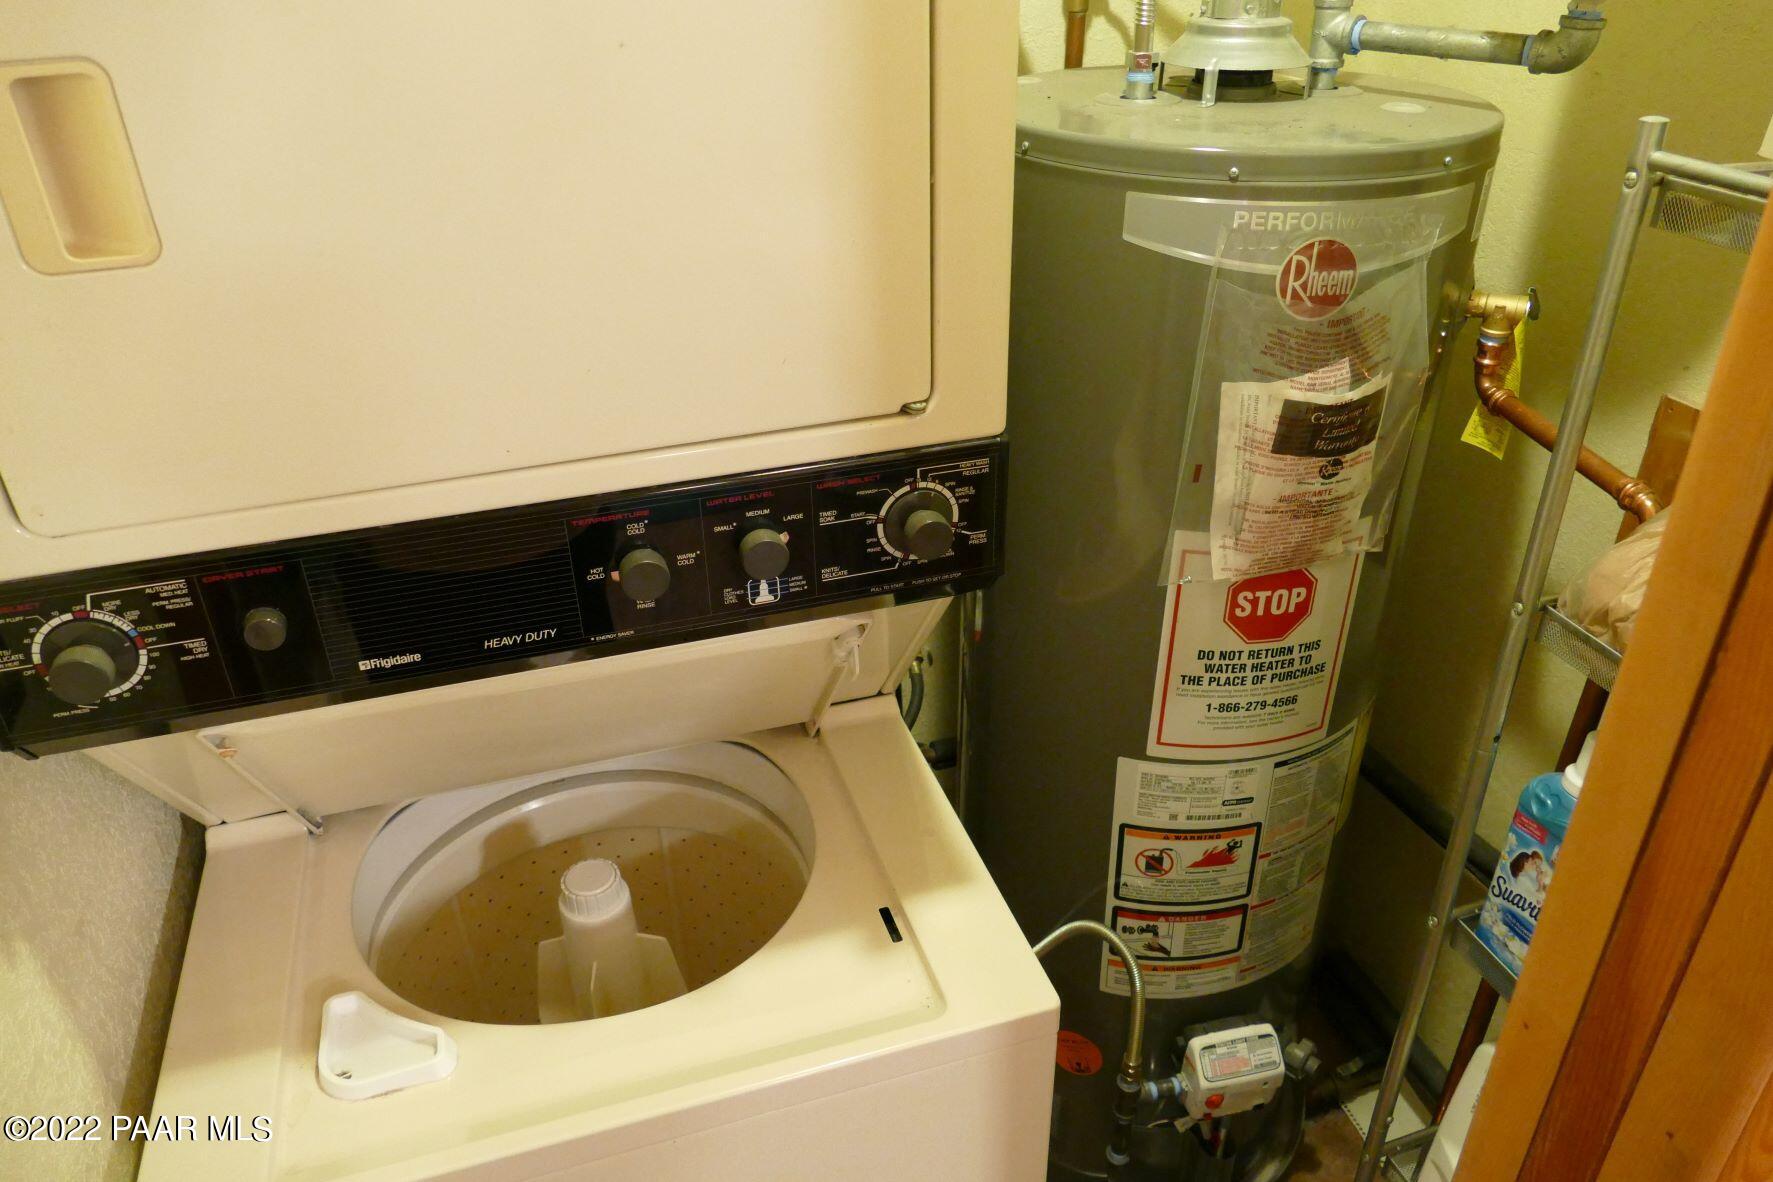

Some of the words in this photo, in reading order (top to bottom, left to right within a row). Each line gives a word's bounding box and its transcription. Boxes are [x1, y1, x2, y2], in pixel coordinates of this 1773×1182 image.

[1286, 242, 1353, 307] Rheem
[962, 468, 989, 476] REGULAR
[745, 508, 770, 517] MEDIUM
[783, 513, 804, 521] LARGE
[626, 522, 645, 530] COLD
[713, 525, 734, 533] SMALL
[677, 552, 696, 560] WARM
[677, 558, 695, 566] COLD
[587, 573, 606, 581] COLD
[822, 569, 848, 579] DELICATE
[145, 582, 188, 594] AUTOMATIC
[1235, 587, 1307, 618] STOP
[137, 624, 155, 632] COOL
[155, 621, 176, 630] DOWN
[484, 634, 523, 650] HEAVY
[525, 628, 557, 643] DUTY
[183, 640, 208, 649] TIMED
[193, 646, 209, 654] DRY
[1197, 649, 1215, 661] DO
[1218, 649, 1245, 661] NOT
[1247, 645, 1295, 660] RETURN
[1298, 639, 1322, 654] THIS
[369, 651, 422, 669] Frigidaire
[1204, 662, 1248, 674] WATER
[1250, 659, 1295, 673] HEATER
[1299, 654, 1313, 666] TO
[1180, 674, 1204, 686] THE
[1207, 675, 1248, 687] PLACE
[1251, 674, 1267, 685] OF
[1270, 662, 1327, 683] PURCHASE
[1205, 694, 1299, 714] 1-866-279-4566
